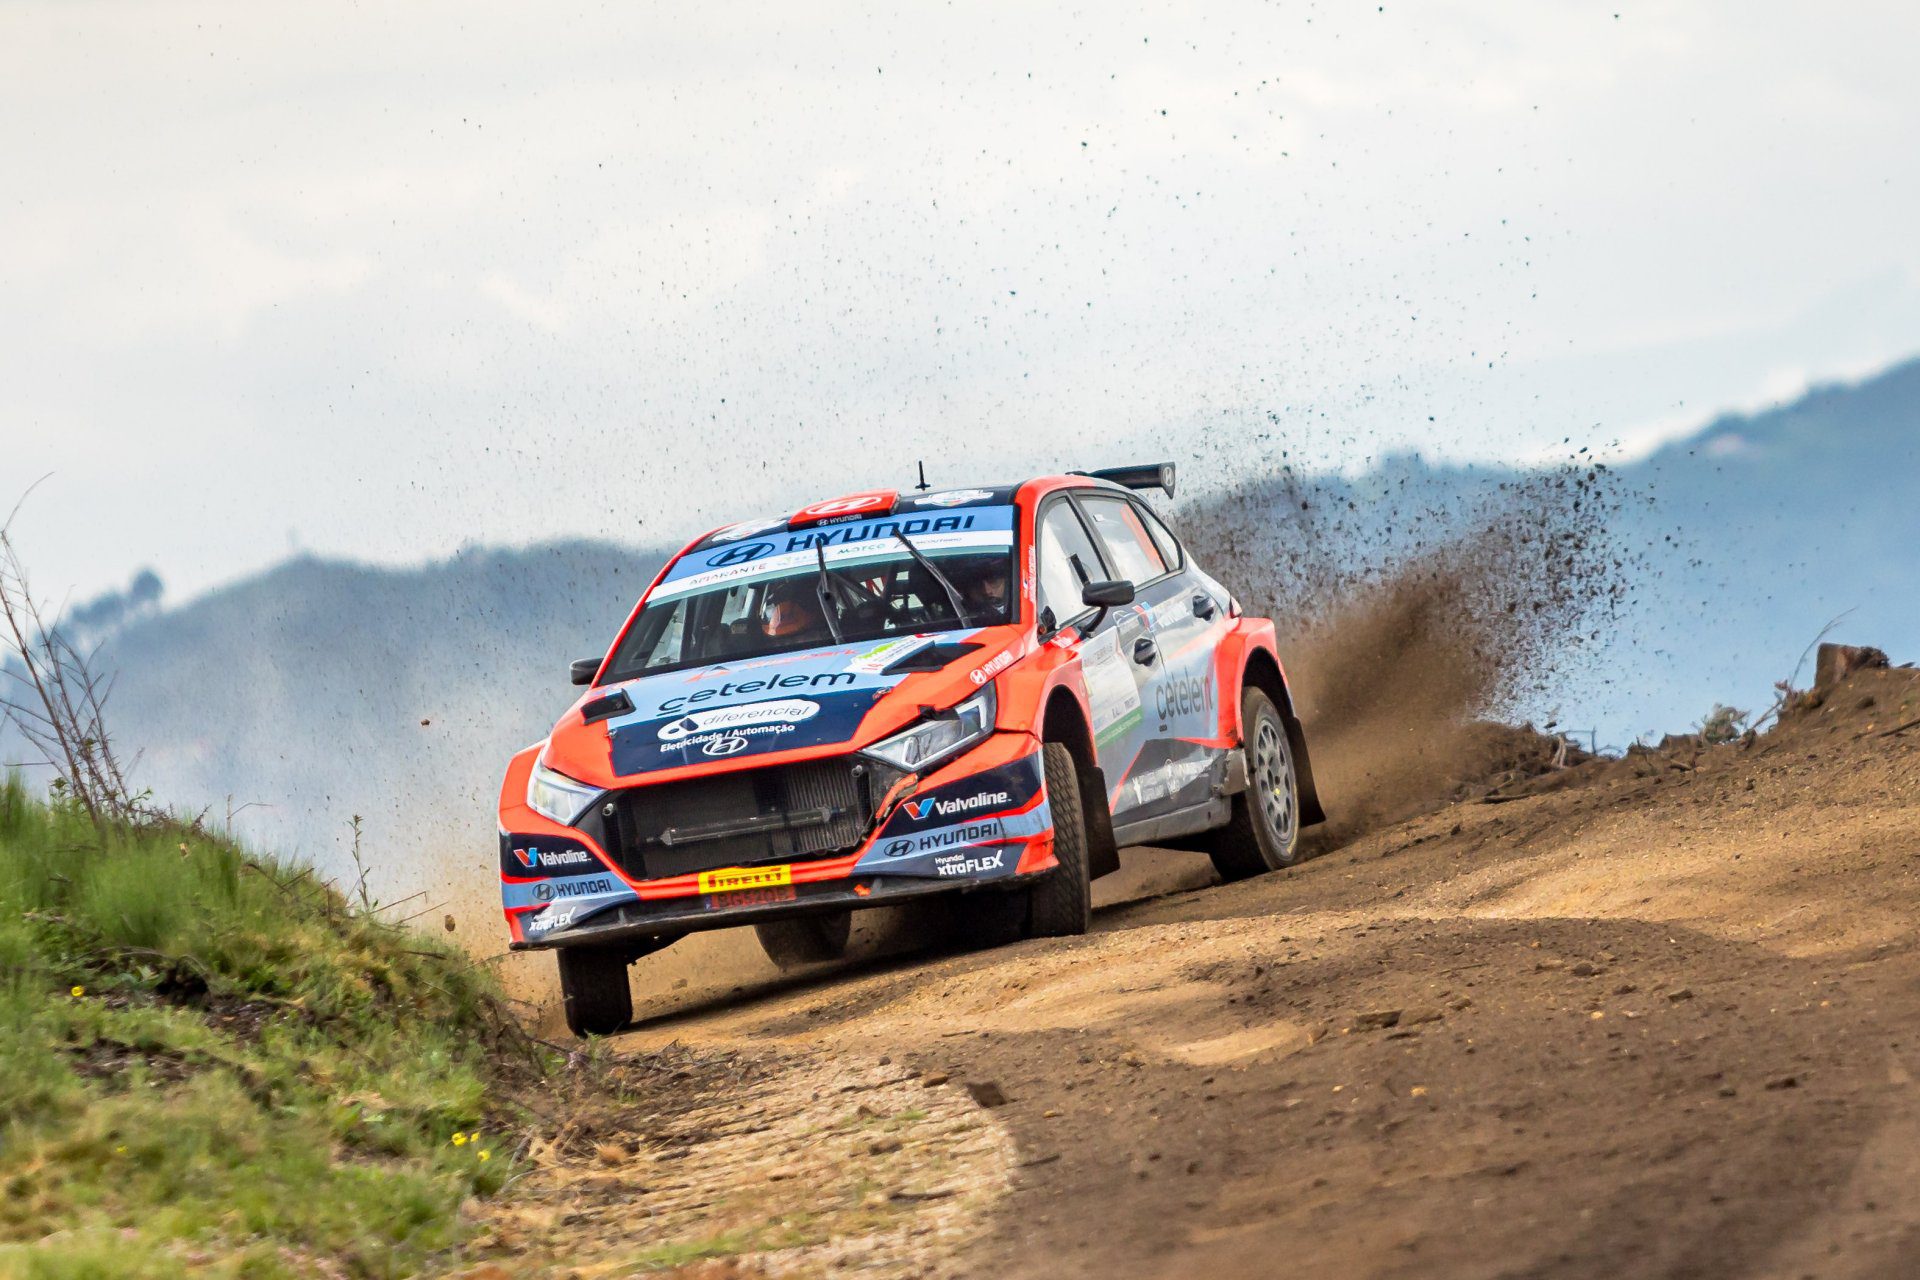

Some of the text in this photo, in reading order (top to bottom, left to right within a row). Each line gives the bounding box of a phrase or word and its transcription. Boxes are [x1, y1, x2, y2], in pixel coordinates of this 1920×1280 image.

[829, 514, 862, 525] HYUNDAI
[785, 515, 975, 552] HYUNDAI
[982, 649, 1014, 676] HYUNDAI
[656, 672, 857, 714] cetelem
[703, 706, 810, 726] diferencial
[660, 731, 723, 752] Eletricidade
[731, 724, 795, 738] Automação
[935, 791, 1008, 815] Valvoline
[919, 823, 997, 850] HYUNDAI
[538, 849, 588, 866] Valvoline
[935, 852, 965, 865] Hyundai
[936, 850, 1004, 876] xtraFLEX
[556, 879, 612, 897] HYUNDAI
[708, 867, 781, 888] PIRELLI
